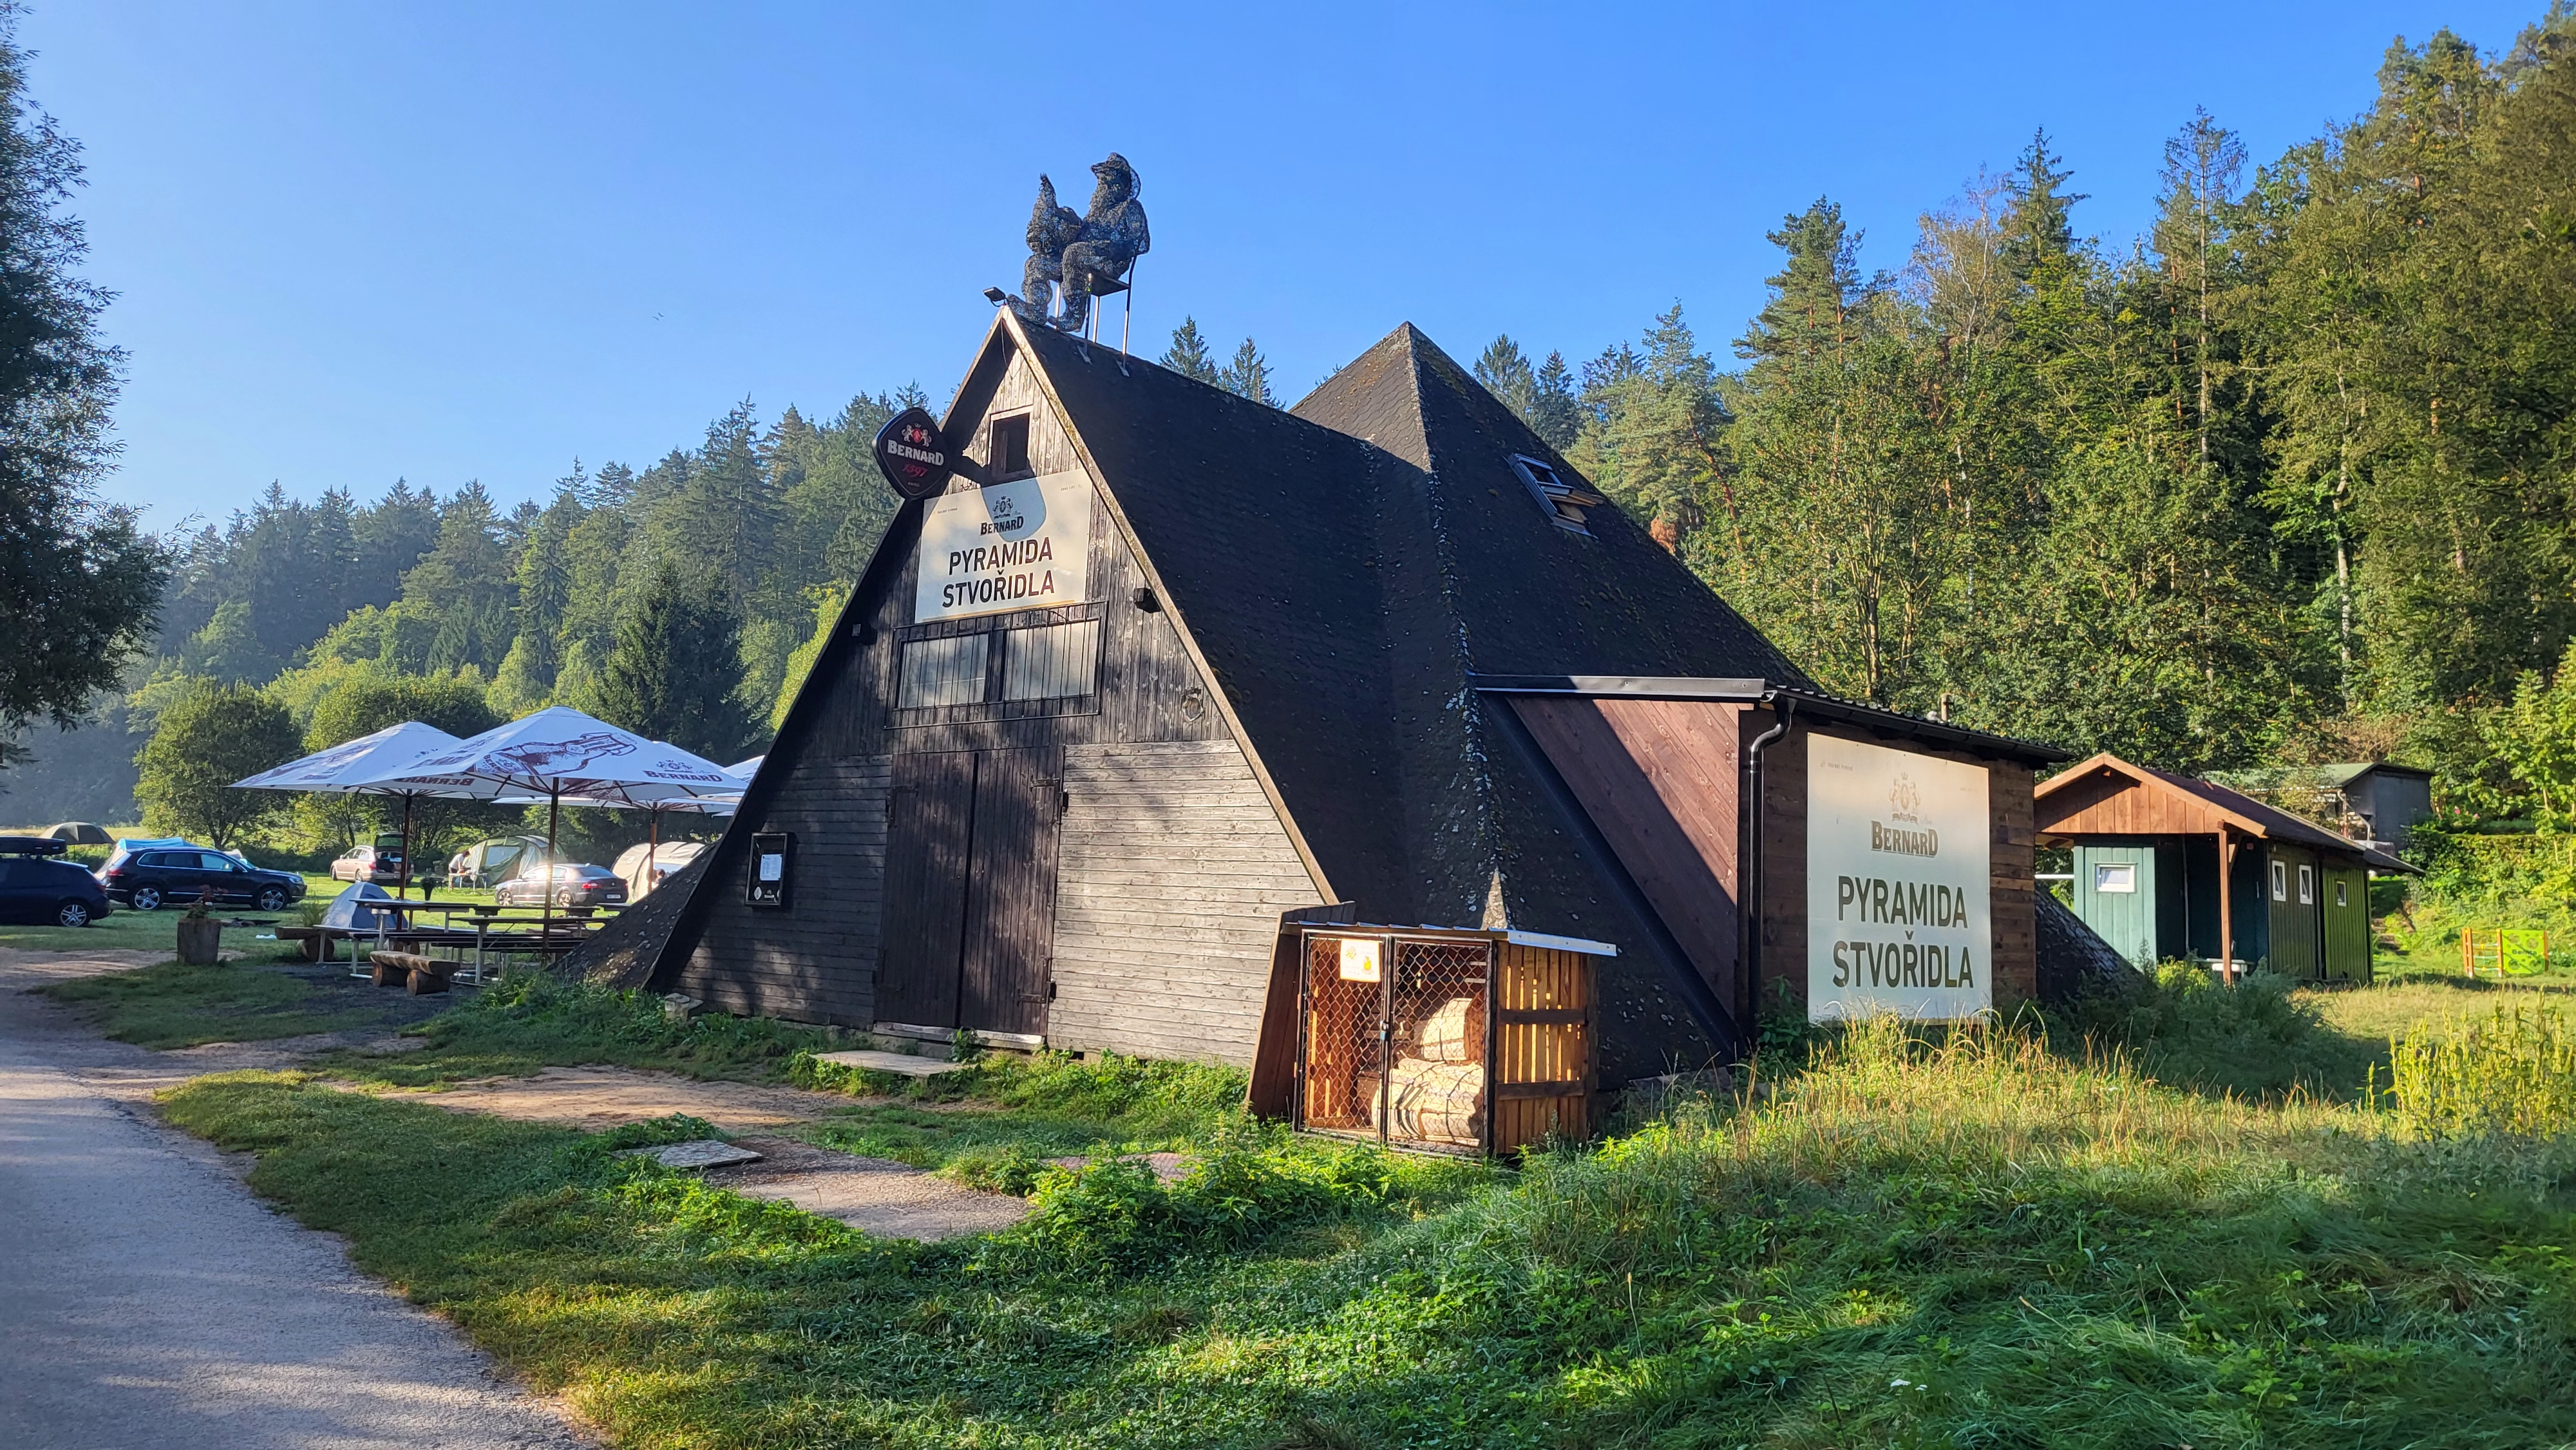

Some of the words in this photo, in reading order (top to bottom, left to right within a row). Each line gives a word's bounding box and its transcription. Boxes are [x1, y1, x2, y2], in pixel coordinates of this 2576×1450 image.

[887, 439, 944, 466] BERNARD
[980, 516, 1024, 536] BERNARD
[949, 536, 1053, 575] PYRAMIDA
[942, 570, 1055, 608] STVOŘIDLA
[642, 770, 723, 782] BERNARD
[1871, 820, 1938, 858] BERNARD
[1837, 875, 1968, 929] PYRAMIDA
[1832, 930, 1974, 988] STVOŘIDLA
